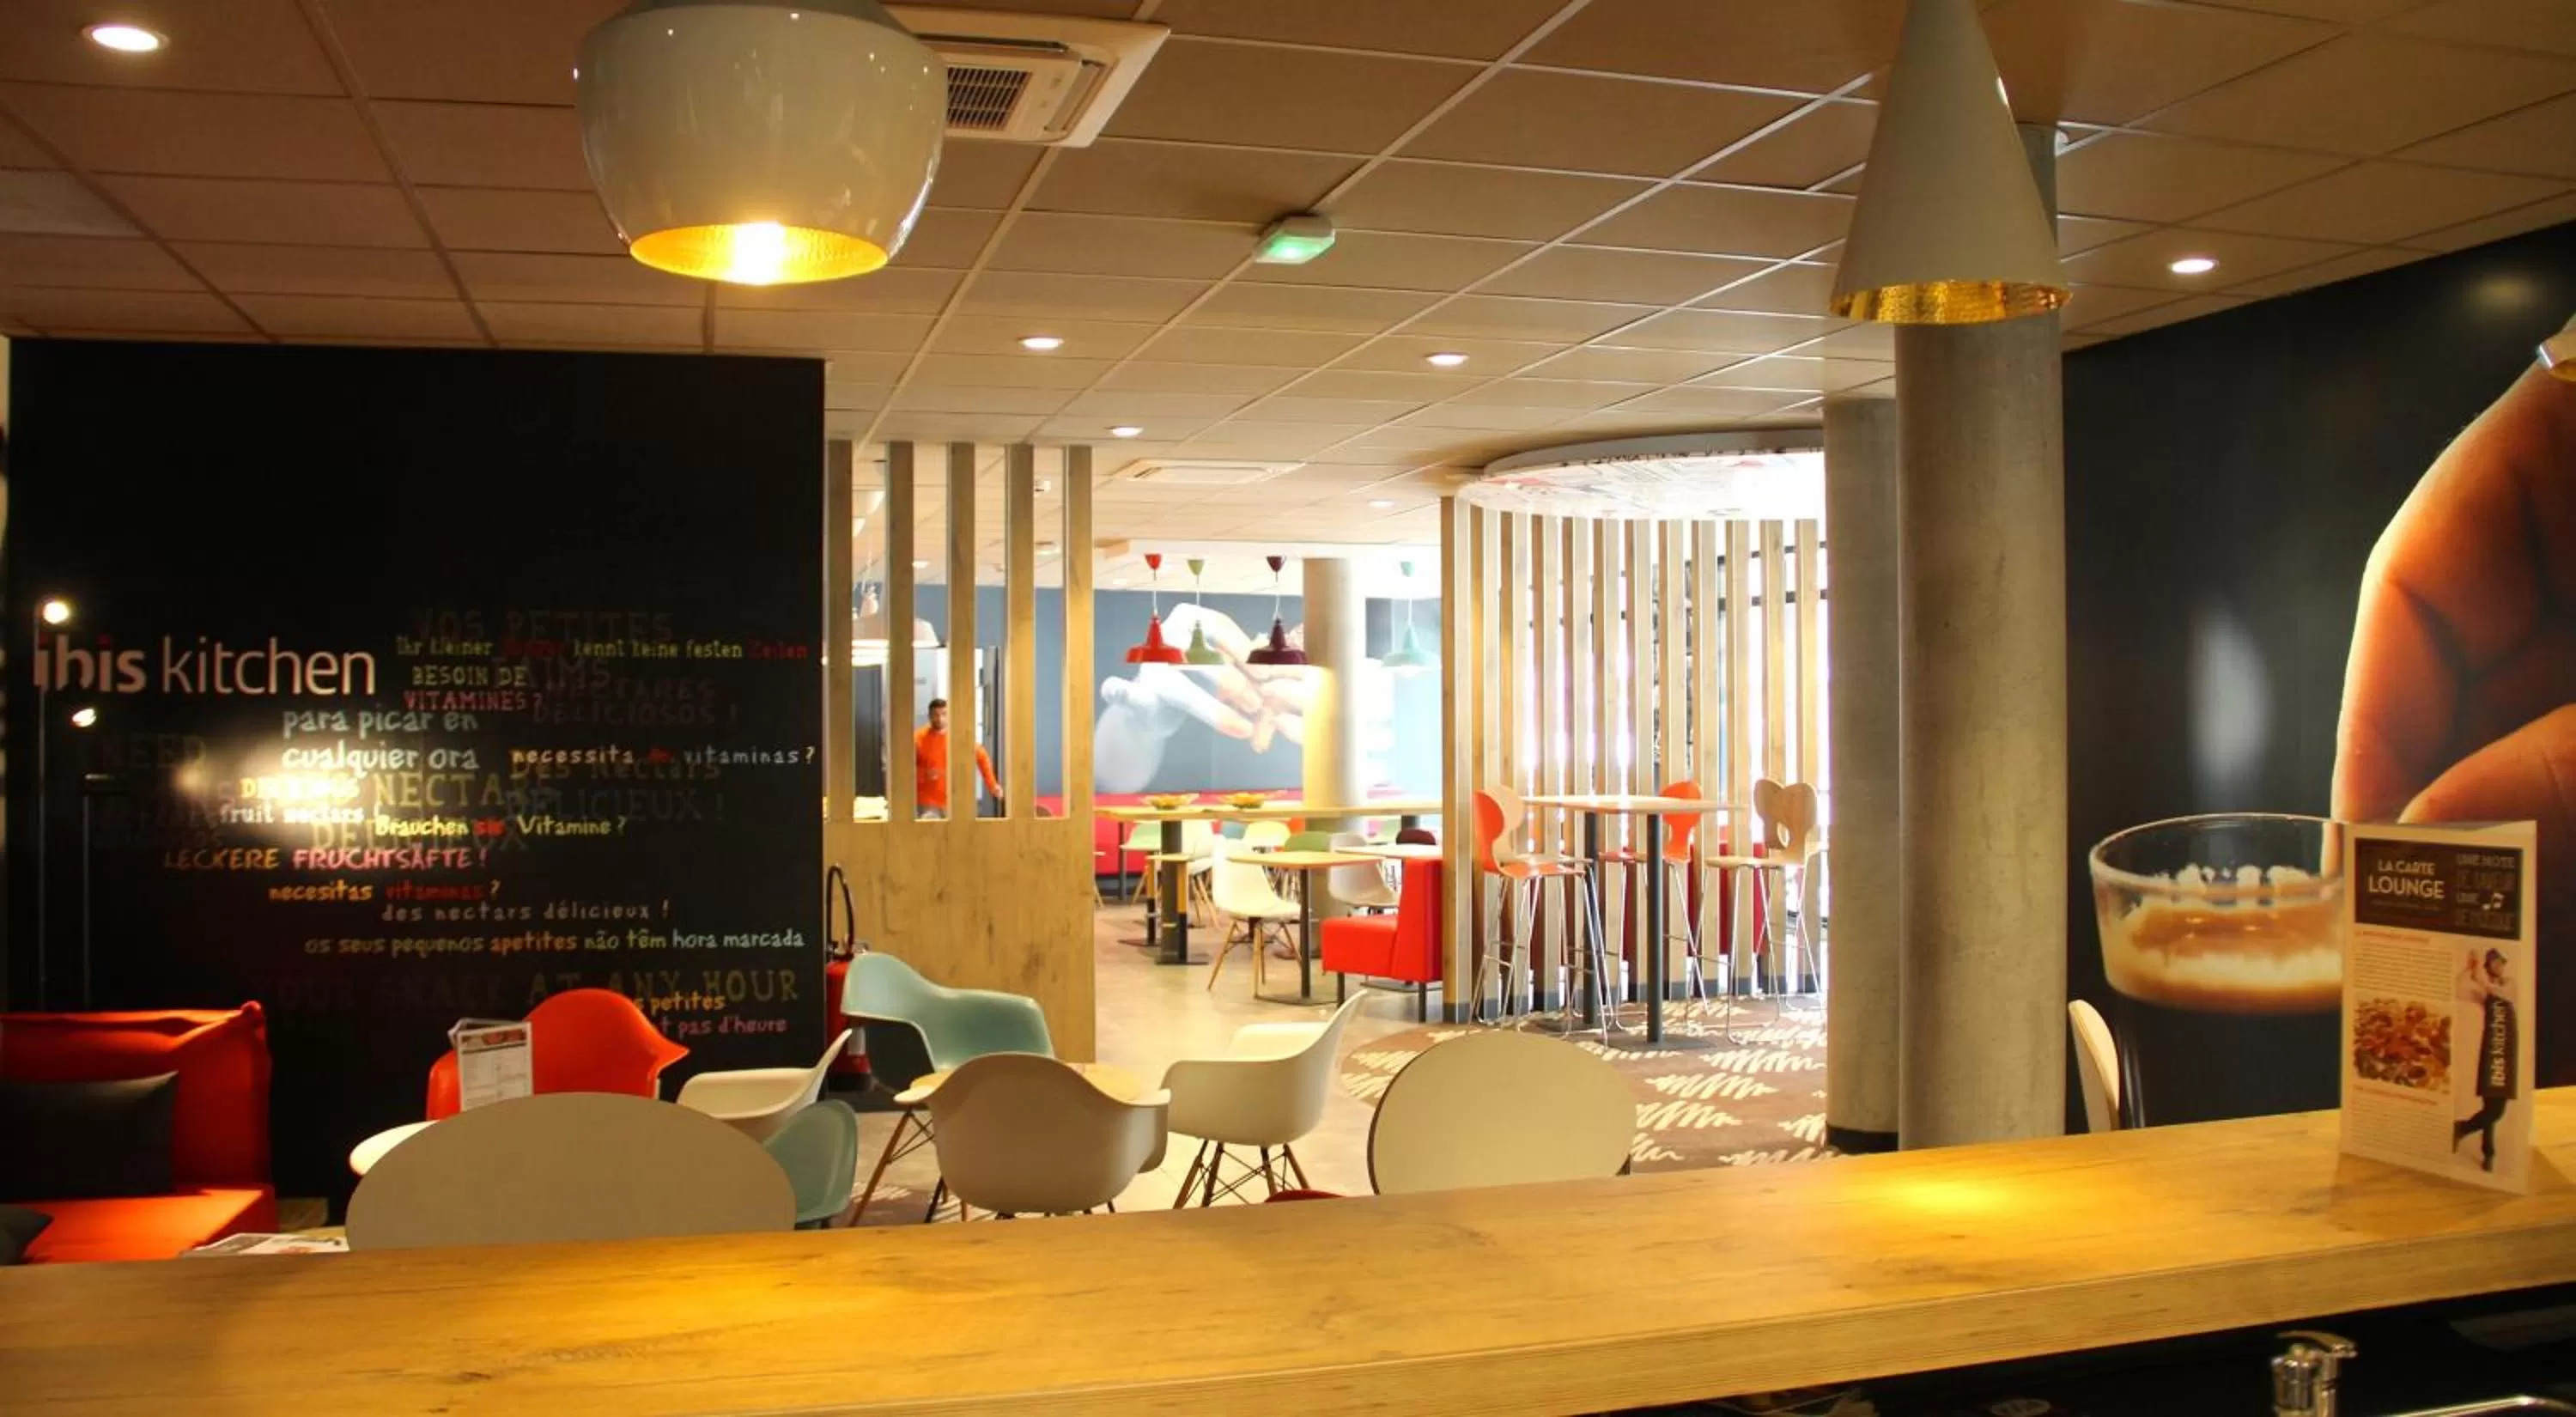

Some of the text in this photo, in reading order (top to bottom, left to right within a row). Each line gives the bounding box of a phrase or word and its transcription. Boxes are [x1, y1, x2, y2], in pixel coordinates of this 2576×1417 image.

[686, 639, 743, 659] festen
[33, 632, 376, 695] ibis kitchen
[412, 665, 530, 688] BESOIN DE
[403, 690, 527, 712] VITAMINES
[283, 702, 480, 739] para picar en
[282, 740, 480, 778] cualquier ora
[508, 744, 635, 766] necessita
[220, 801, 274, 824] fruit
[374, 814, 469, 837] Brauchen
[163, 846, 280, 871] LECKERE
[2378, 858, 2437, 877] LA CARTE
[268, 880, 374, 903] necesitas
[2367, 873, 2446, 901] LOUNGE
[381, 904, 423, 922] des
[434, 903, 532, 922] nectars
[543, 899, 650, 922] délicieux
[304, 927, 805, 959] os seus pequenos apetites não têm hora marcada
[701, 968, 799, 1004] HOUR
[650, 989, 727, 1017] petites
[677, 1018, 713, 1042] pas
